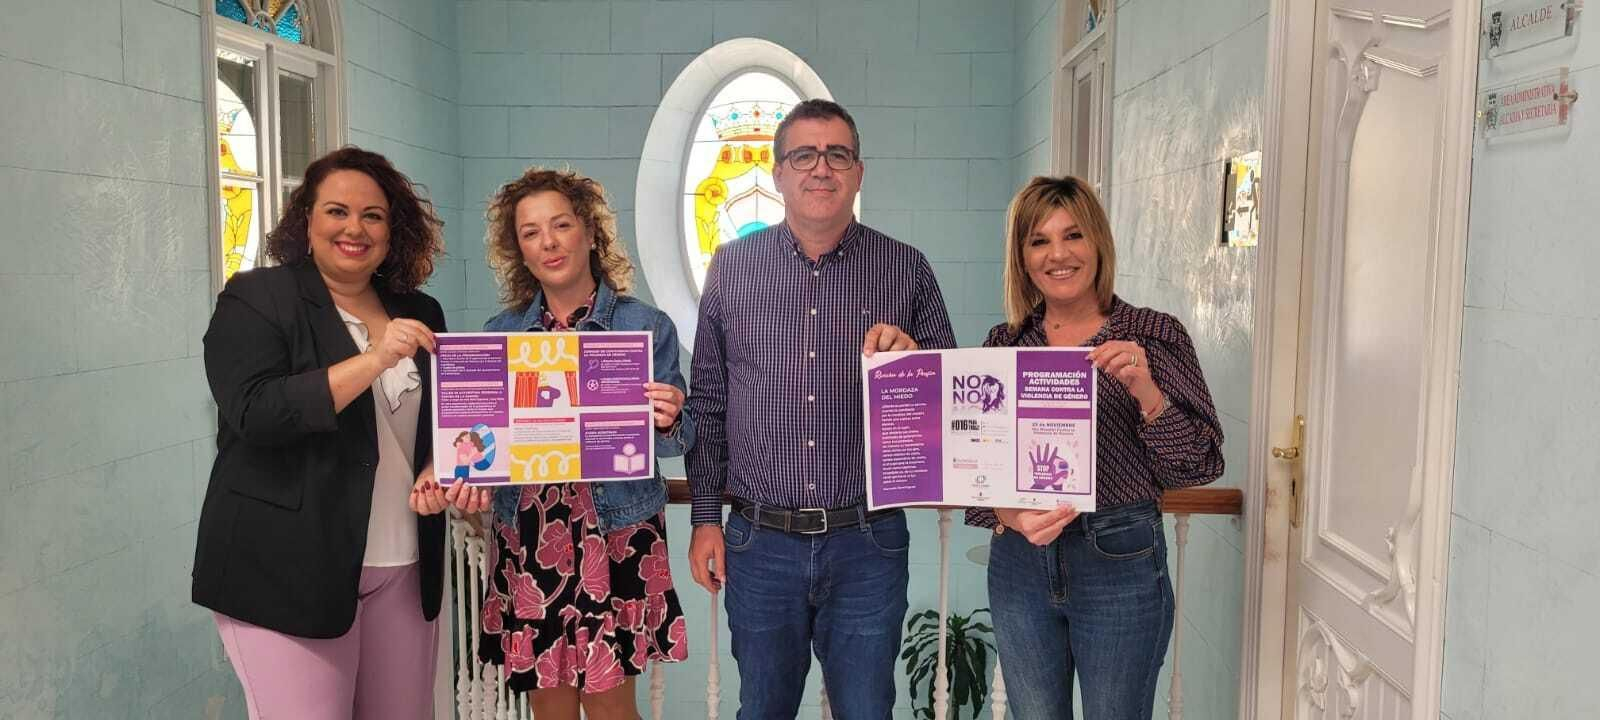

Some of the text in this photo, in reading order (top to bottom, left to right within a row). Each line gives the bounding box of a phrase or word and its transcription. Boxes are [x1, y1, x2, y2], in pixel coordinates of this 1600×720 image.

[1510, 5, 1553, 31] ALCALDE
[1022, 370, 1087, 379] PROGRAMACIÓN
[952, 374, 981, 390] NO
[1028, 378, 1080, 386] ACTIVIDADES
[952, 390, 981, 405] NO
[1063, 392, 1089, 400] GÉNERO
[1037, 464, 1050, 472] STOP
